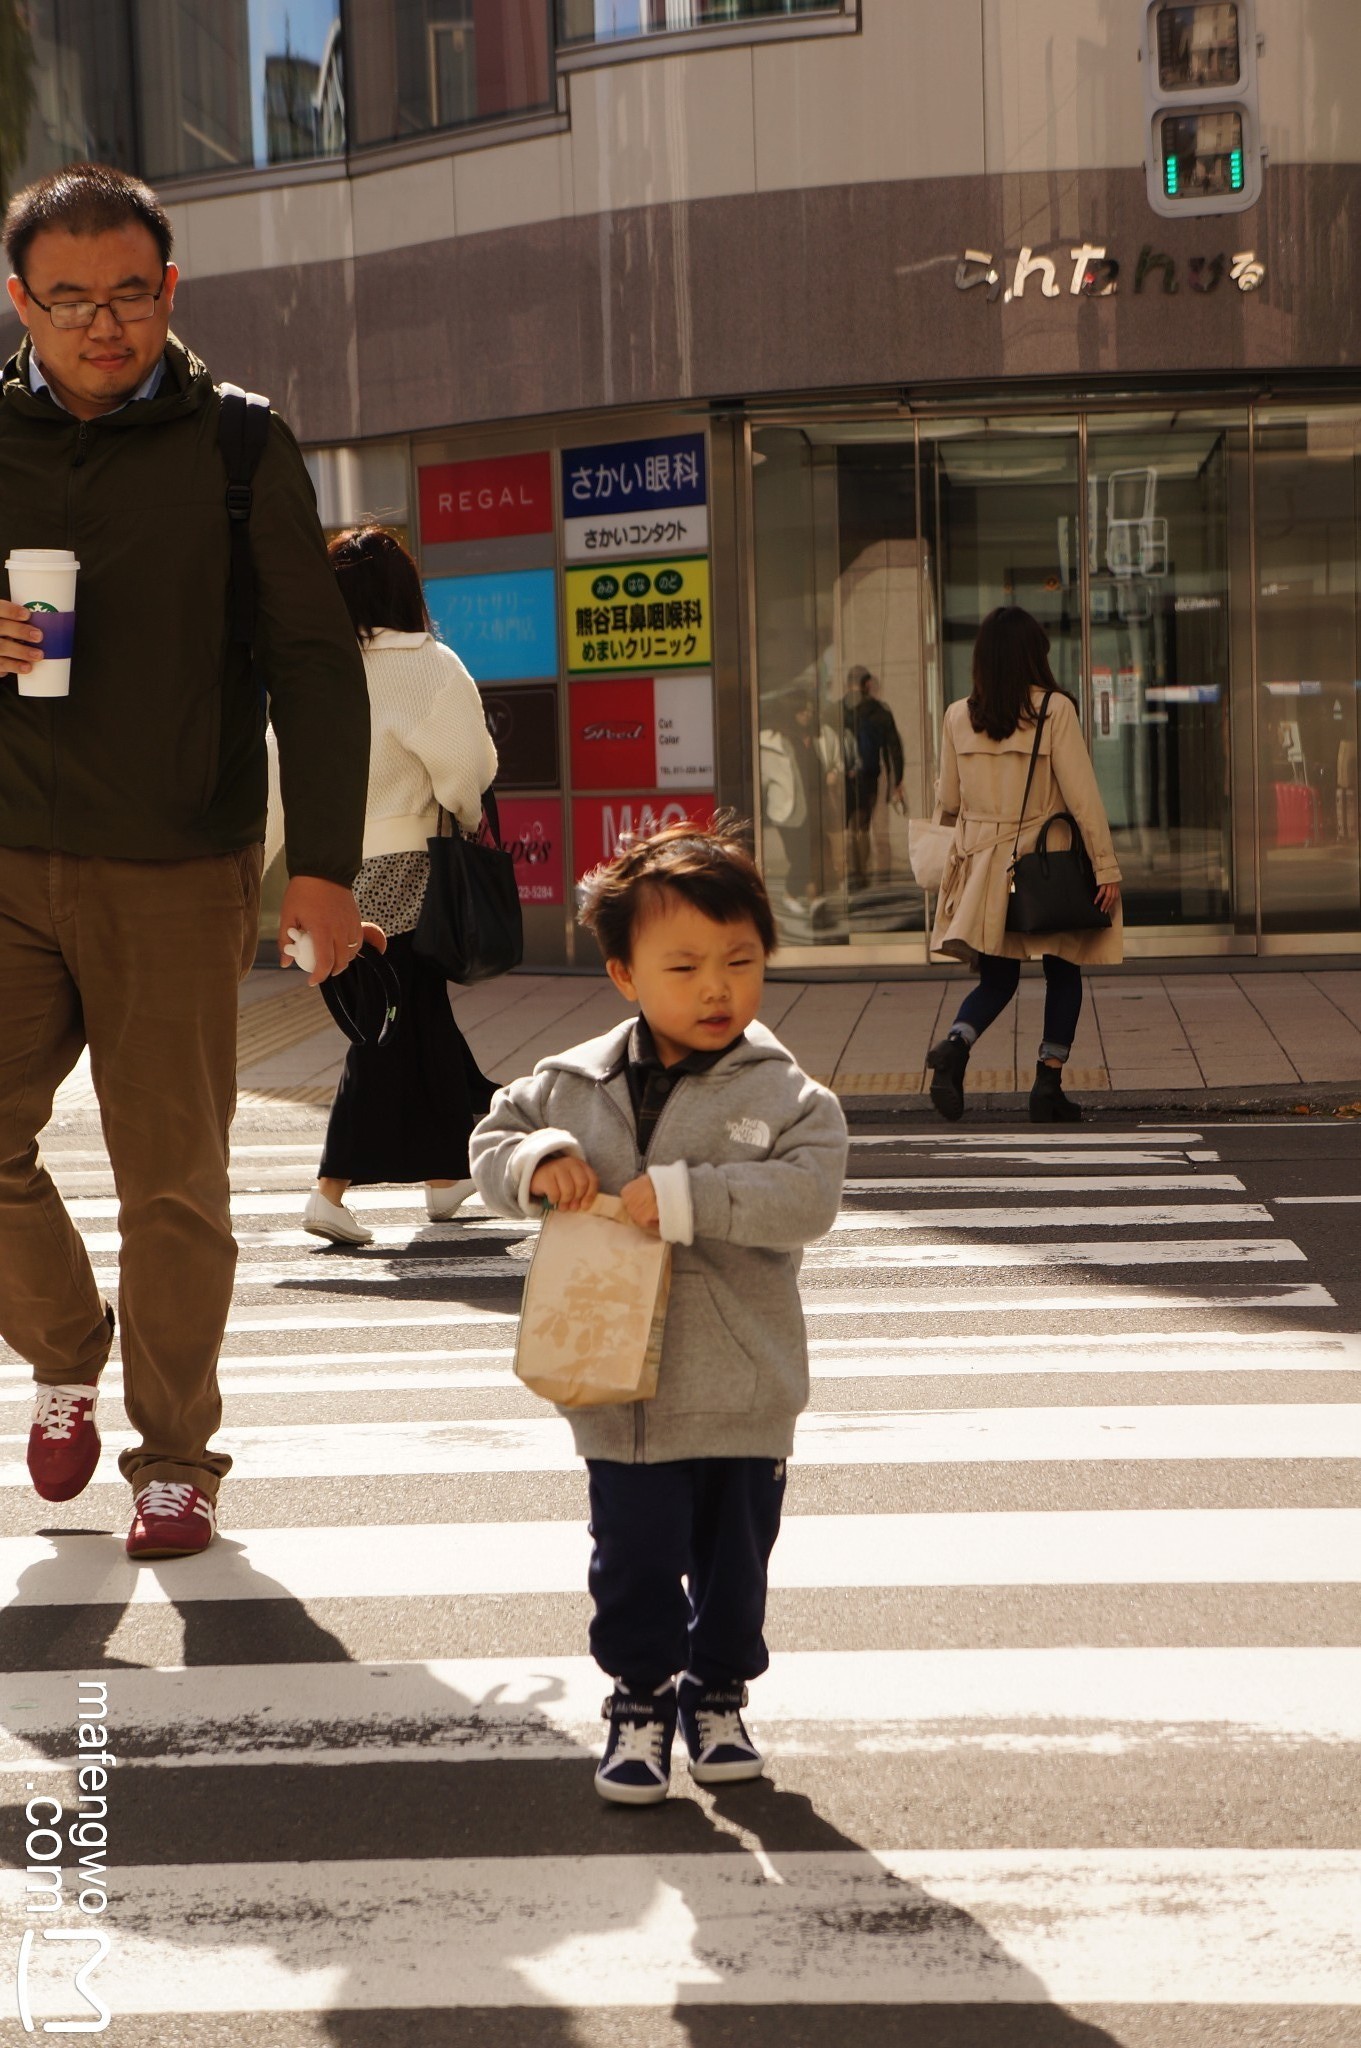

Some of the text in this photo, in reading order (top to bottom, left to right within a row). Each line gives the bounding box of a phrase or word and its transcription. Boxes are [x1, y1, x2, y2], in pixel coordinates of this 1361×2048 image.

[570, 450, 699, 500] さかい眼科
[438, 486, 534, 513] REGAL
[584, 520, 687, 549] さかいコンタクト
[658, 574, 678, 590] のど
[576, 598, 702, 637] 熊谷耳鼻咽喉科
[582, 634, 697, 662] めまいクリニック
[658, 718, 673, 729] Cut
[659, 735, 680, 745] Color
